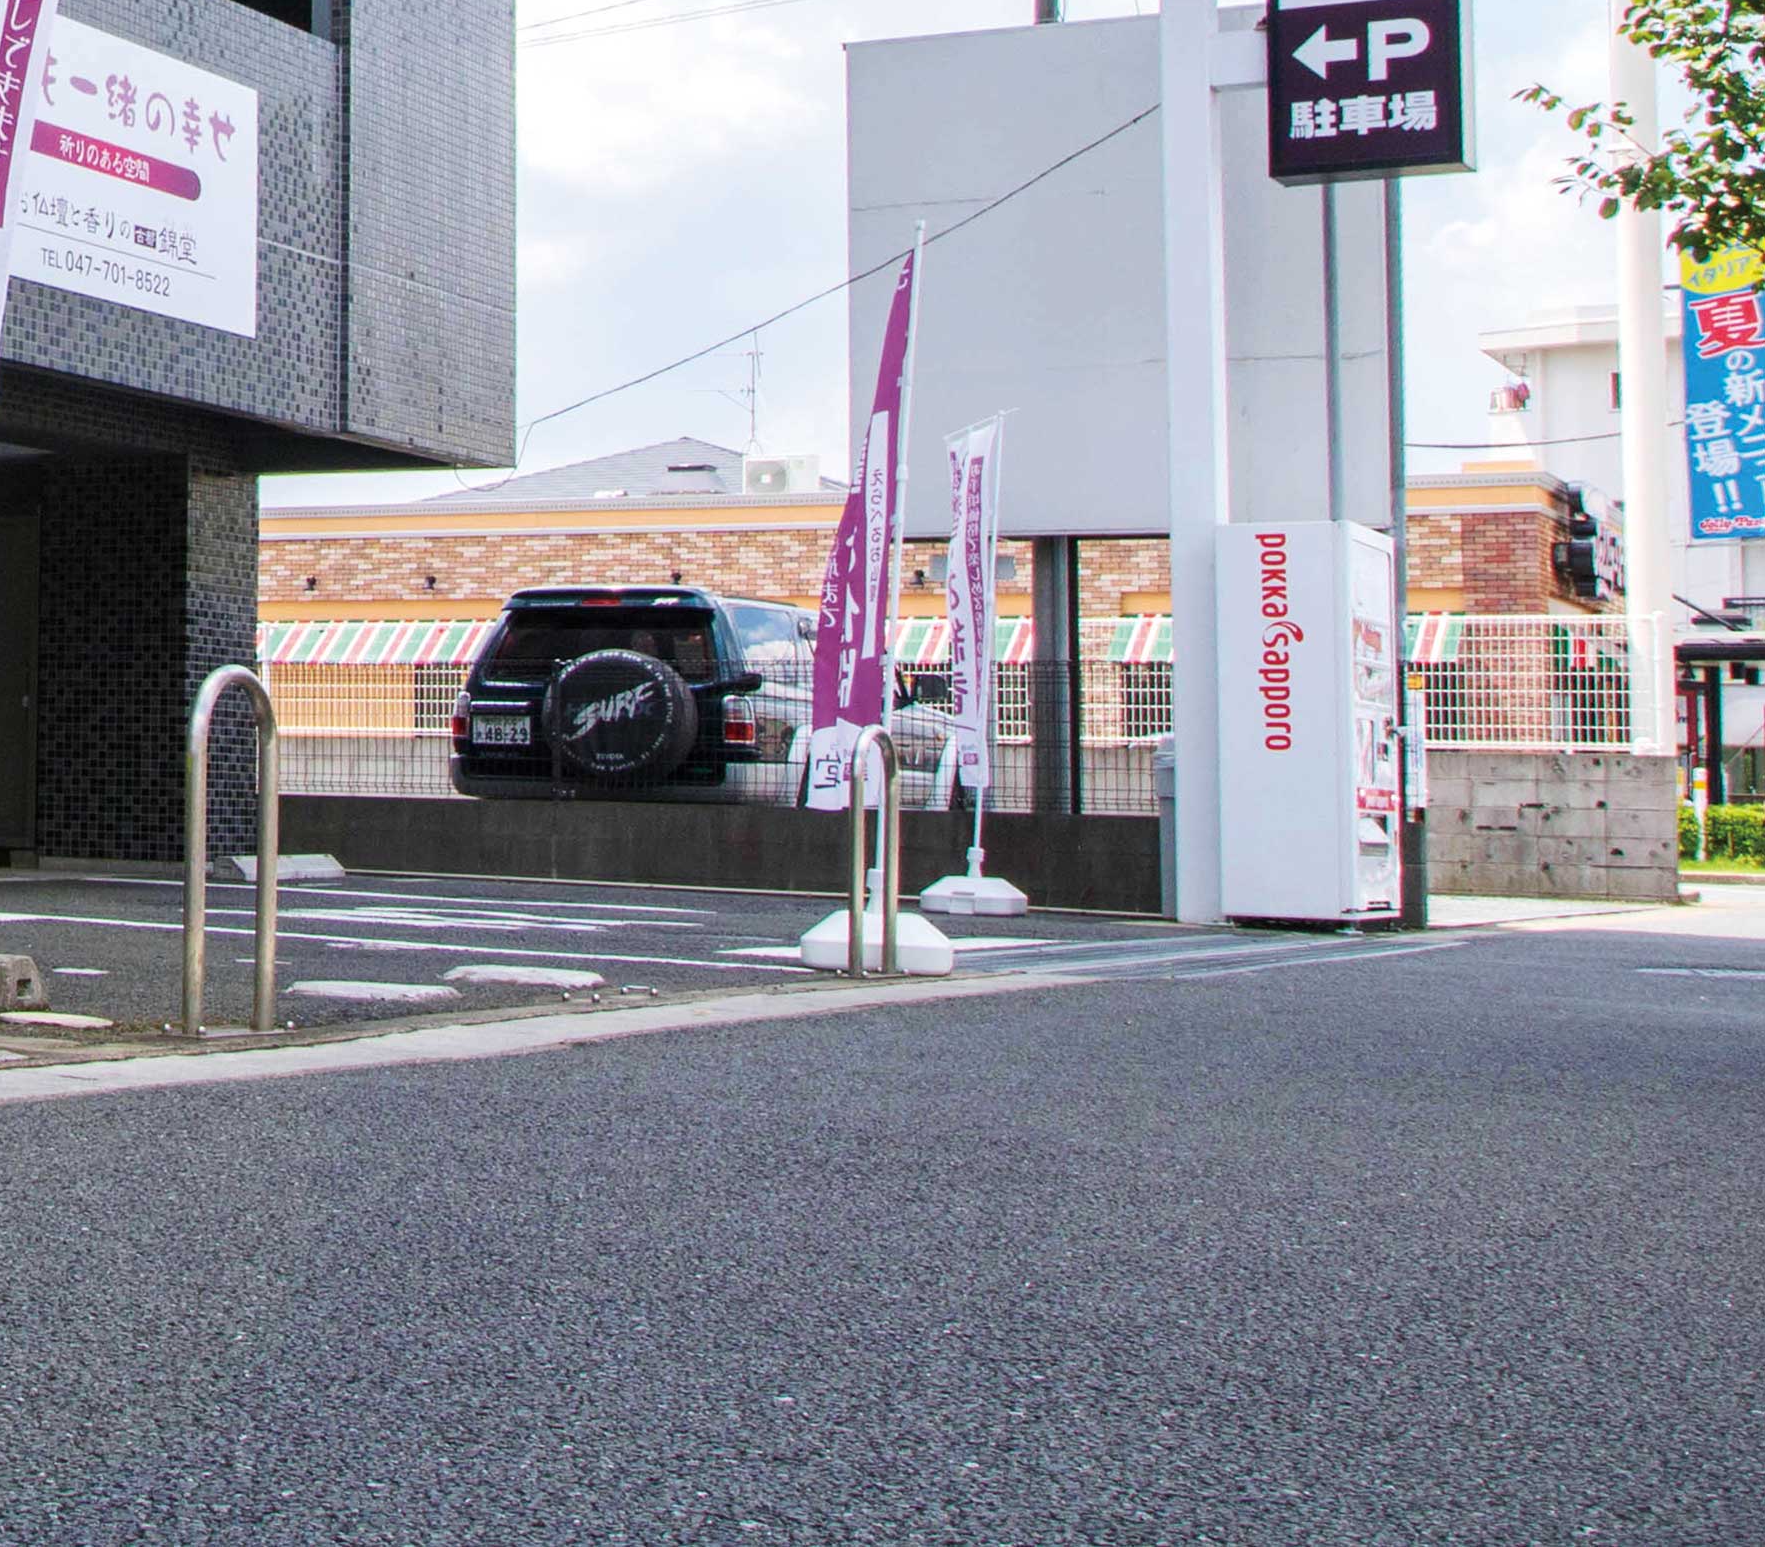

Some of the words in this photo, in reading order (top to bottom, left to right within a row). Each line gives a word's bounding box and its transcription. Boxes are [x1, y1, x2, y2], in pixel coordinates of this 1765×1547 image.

[1367, 18, 1431, 82] P
[1288, 89, 1438, 142] 駐車場
[58, 133, 151, 184] 祈りのある空間
[157, 225, 198, 266] 錦堂
[41, 247, 63, 270] TEL
[65, 250, 171, 297] 047-701-8522
[566, 680, 657, 741] SURF
